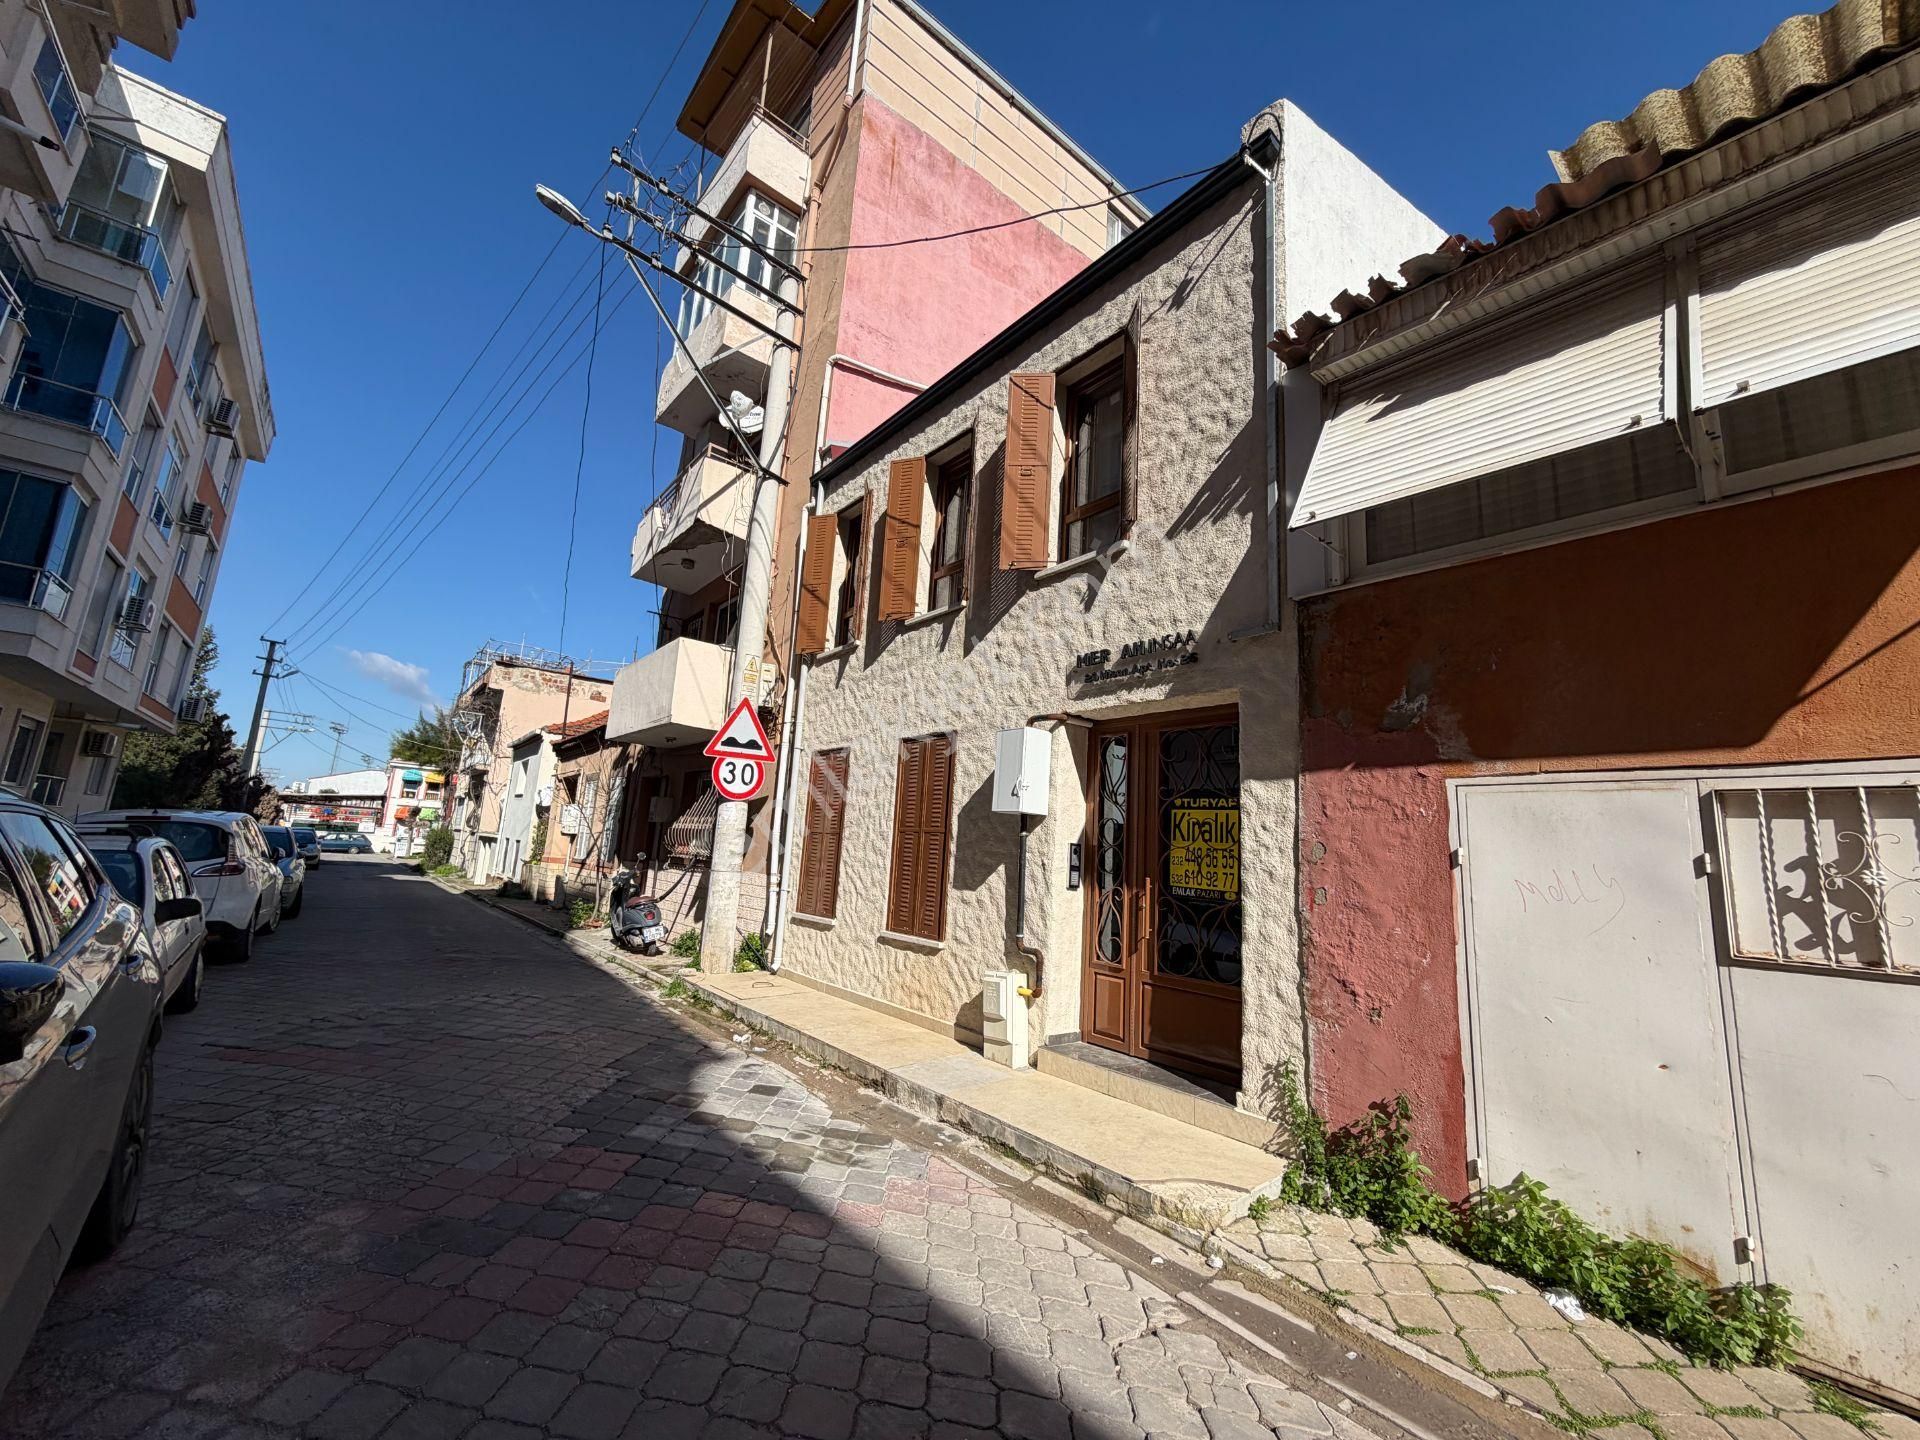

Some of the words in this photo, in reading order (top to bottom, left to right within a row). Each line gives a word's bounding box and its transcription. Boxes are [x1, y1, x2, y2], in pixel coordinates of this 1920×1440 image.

[1077, 648, 1111, 668] MER
[723, 761, 755, 786] 30
[1173, 812, 1236, 843] Kiralık
[1172, 856, 1184, 866] 232
[1206, 848, 1218, 868] 56
[1222, 849, 1235, 869] 55
[1205, 870, 1218, 887] 92
[1222, 872, 1235, 889] 77
[1172, 886, 1196, 897] EMLAK
[1197, 888, 1221, 899] PAZARI
